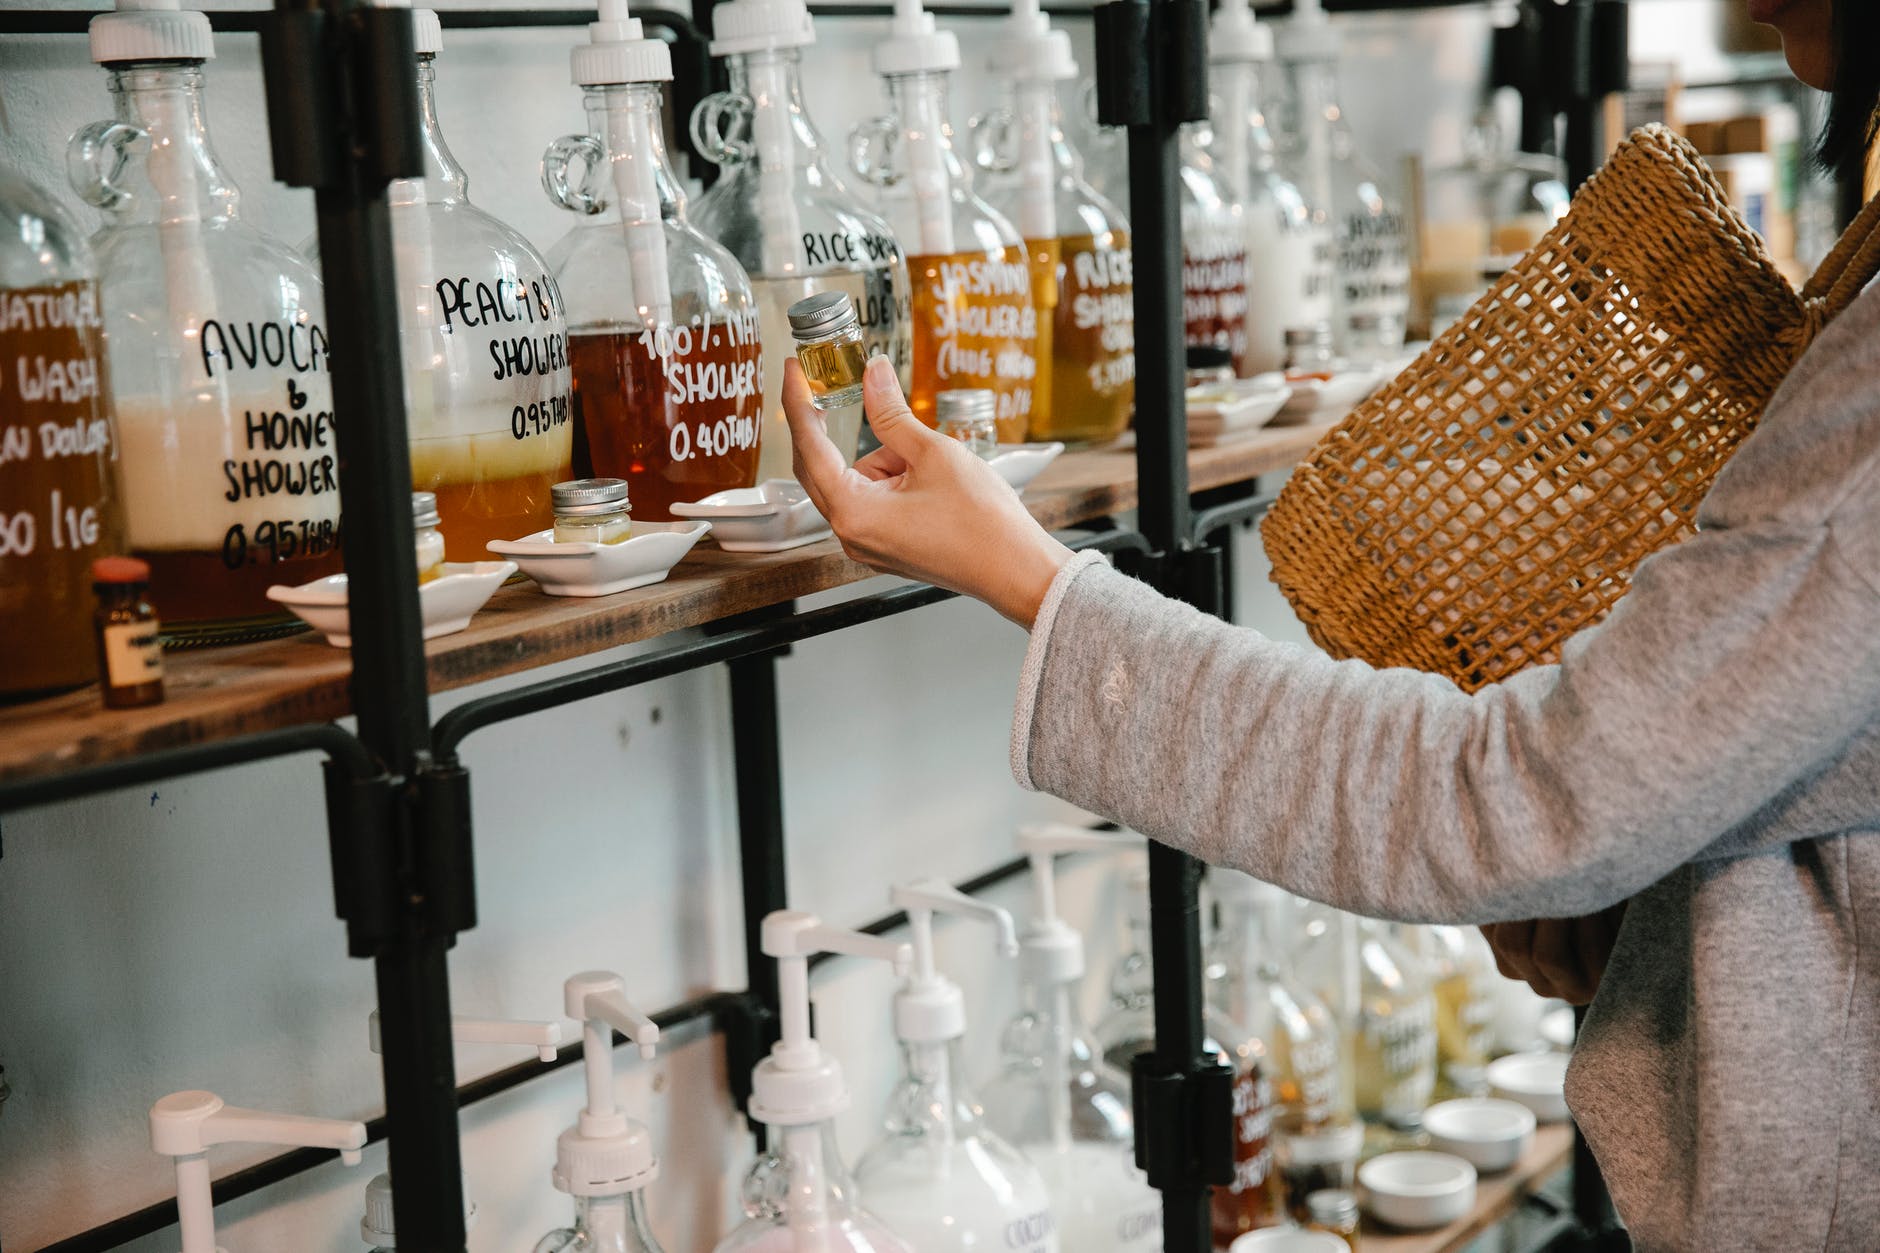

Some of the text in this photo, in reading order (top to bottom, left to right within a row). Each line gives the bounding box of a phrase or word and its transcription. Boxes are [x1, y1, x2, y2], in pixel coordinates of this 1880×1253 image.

[802, 233, 859, 266] RICE
[436, 277, 533, 334] PEACH
[856, 294, 890, 328] LOE
[17, 355, 98, 404] WASH
[489, 333, 566, 380] SHOWER
[668, 358, 756, 405] SHOWER
[224, 454, 336, 502] SHOWER
